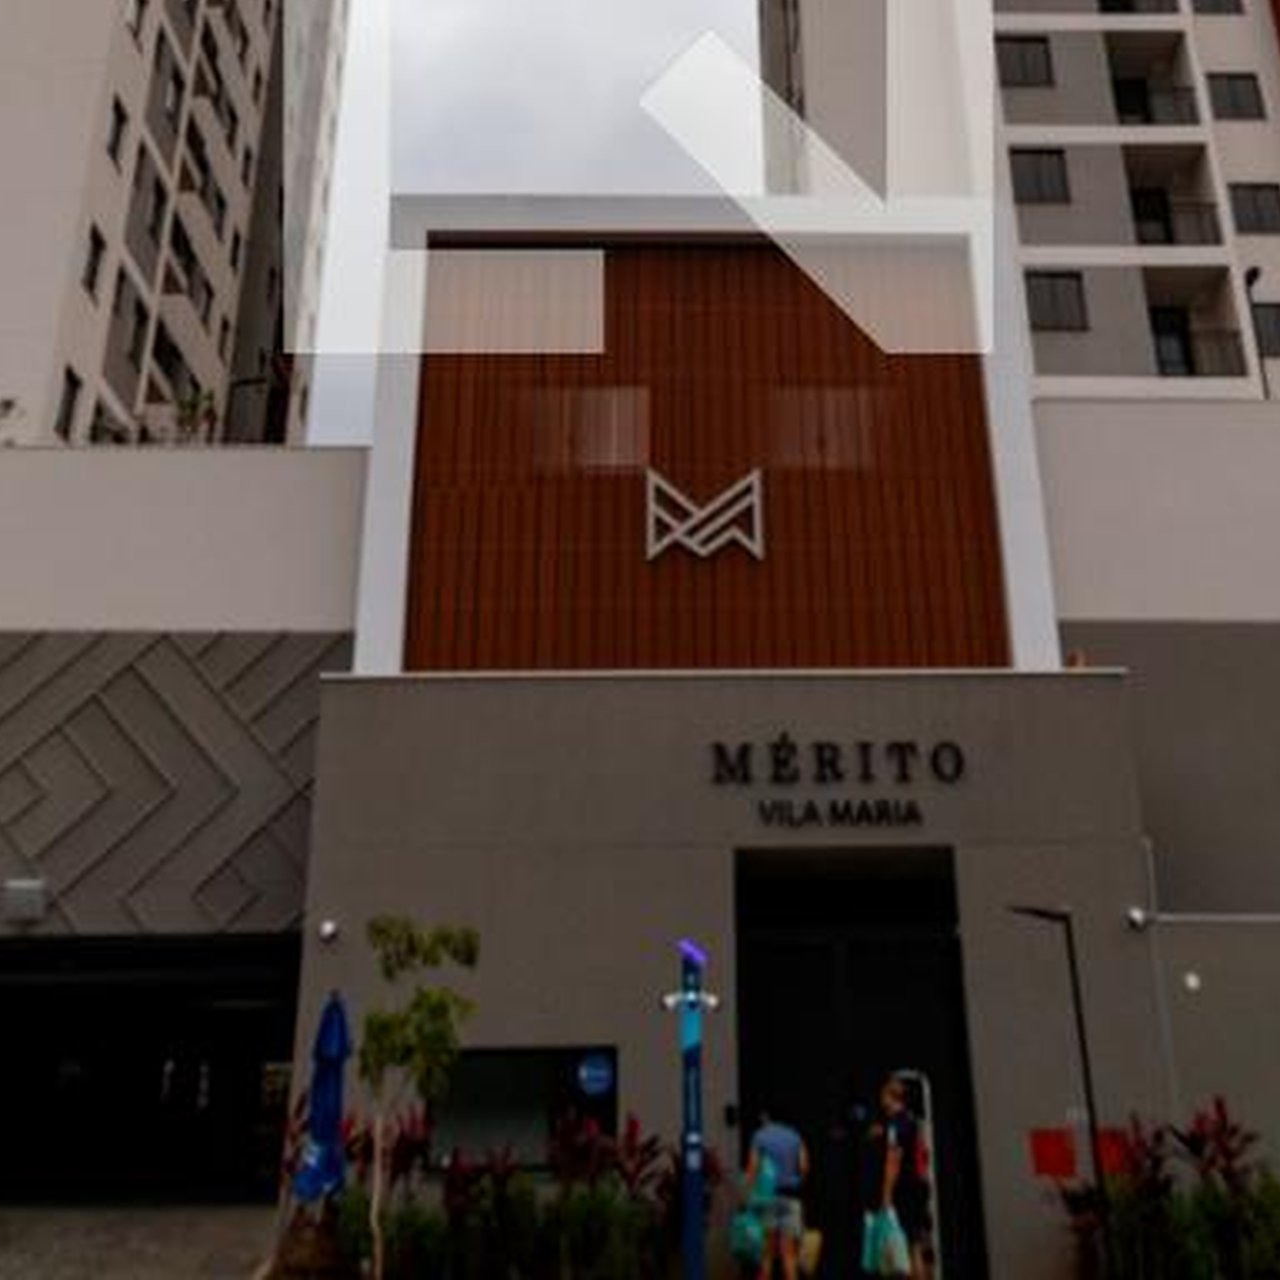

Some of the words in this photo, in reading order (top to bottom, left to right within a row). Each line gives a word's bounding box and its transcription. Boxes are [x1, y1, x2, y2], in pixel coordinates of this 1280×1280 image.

[711, 732, 965, 784] MÉRITO
[758, 800, 821, 827] VILA
[829, 800, 923, 827] MARIA
